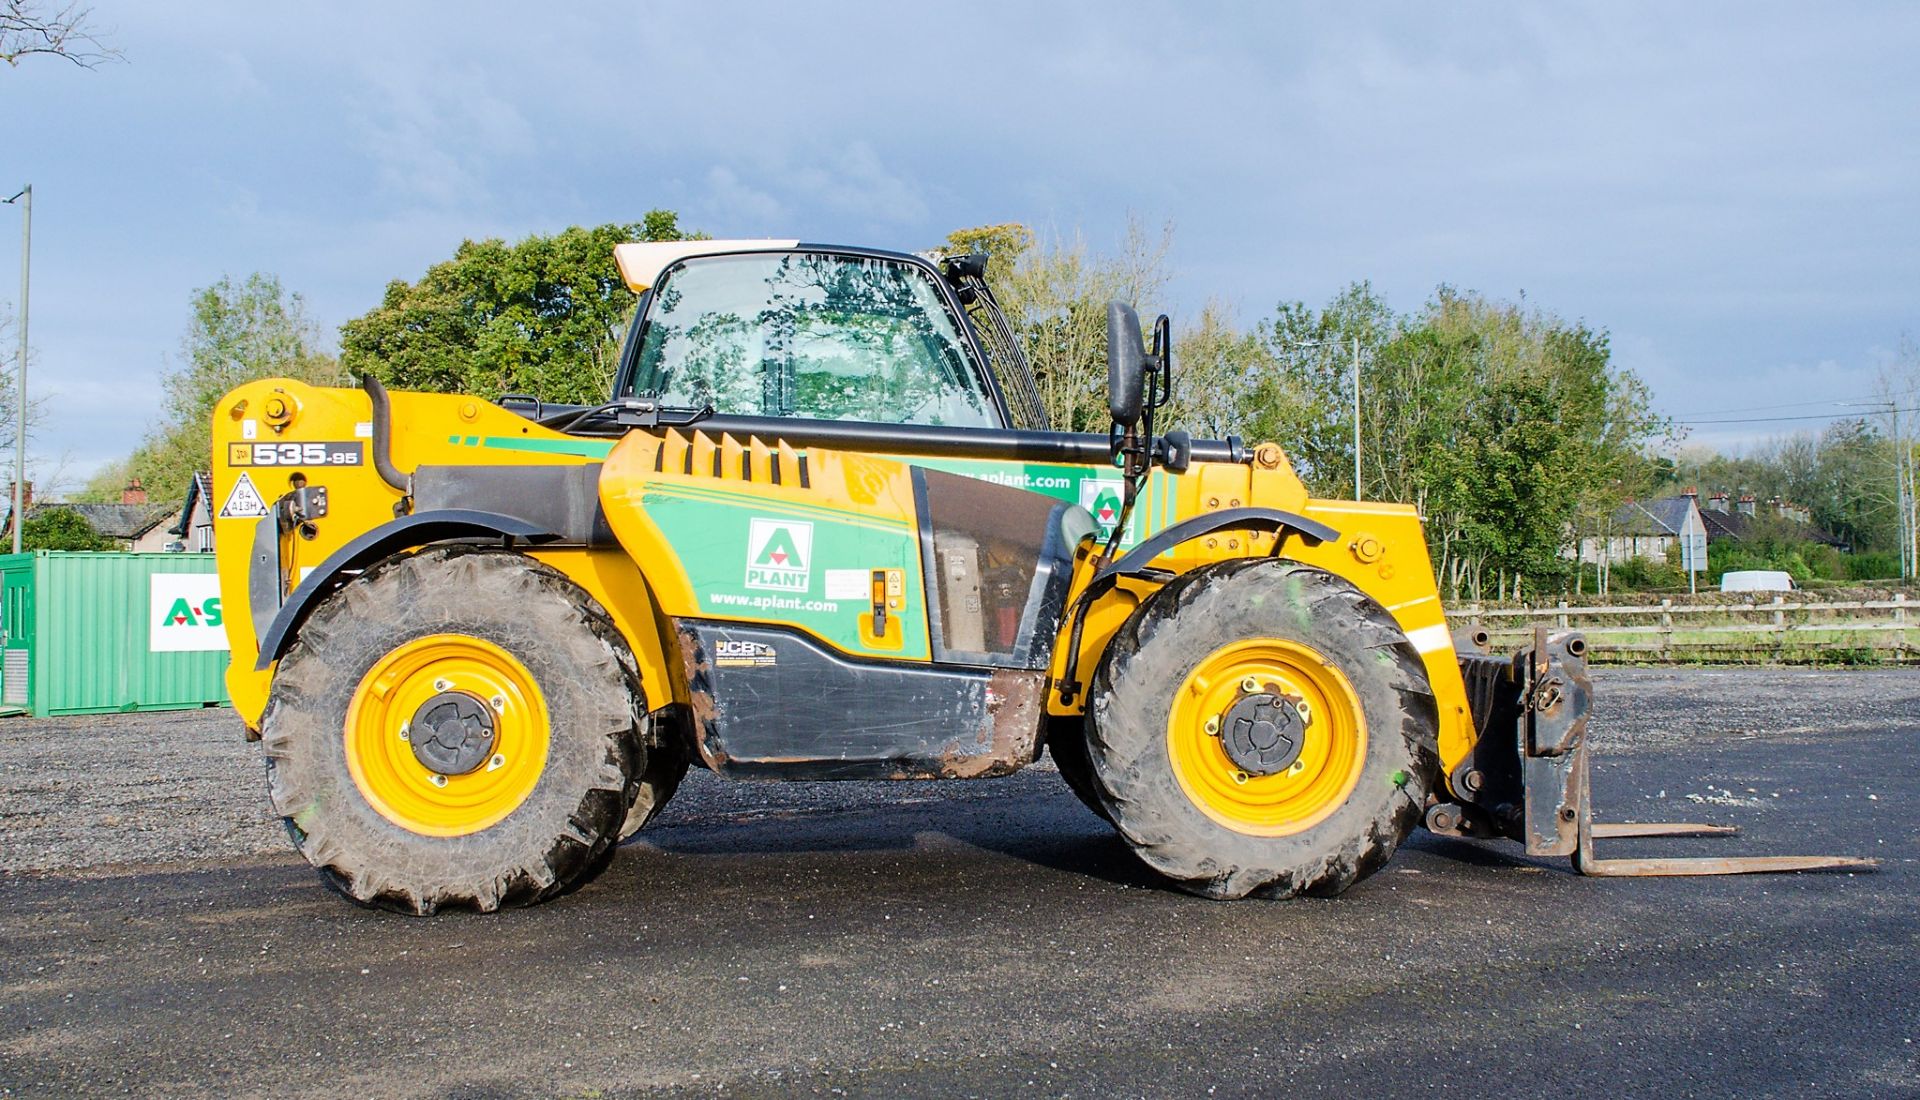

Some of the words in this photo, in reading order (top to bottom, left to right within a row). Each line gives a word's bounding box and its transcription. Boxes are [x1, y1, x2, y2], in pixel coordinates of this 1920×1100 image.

[253, 443, 357, 465] 535-95
[957, 472, 1071, 489] aplant.com
[754, 527, 804, 568] A
[747, 570, 807, 587] PLANT
[710, 593, 838, 612] www.aplant.com
[716, 640, 755, 654] JCB
